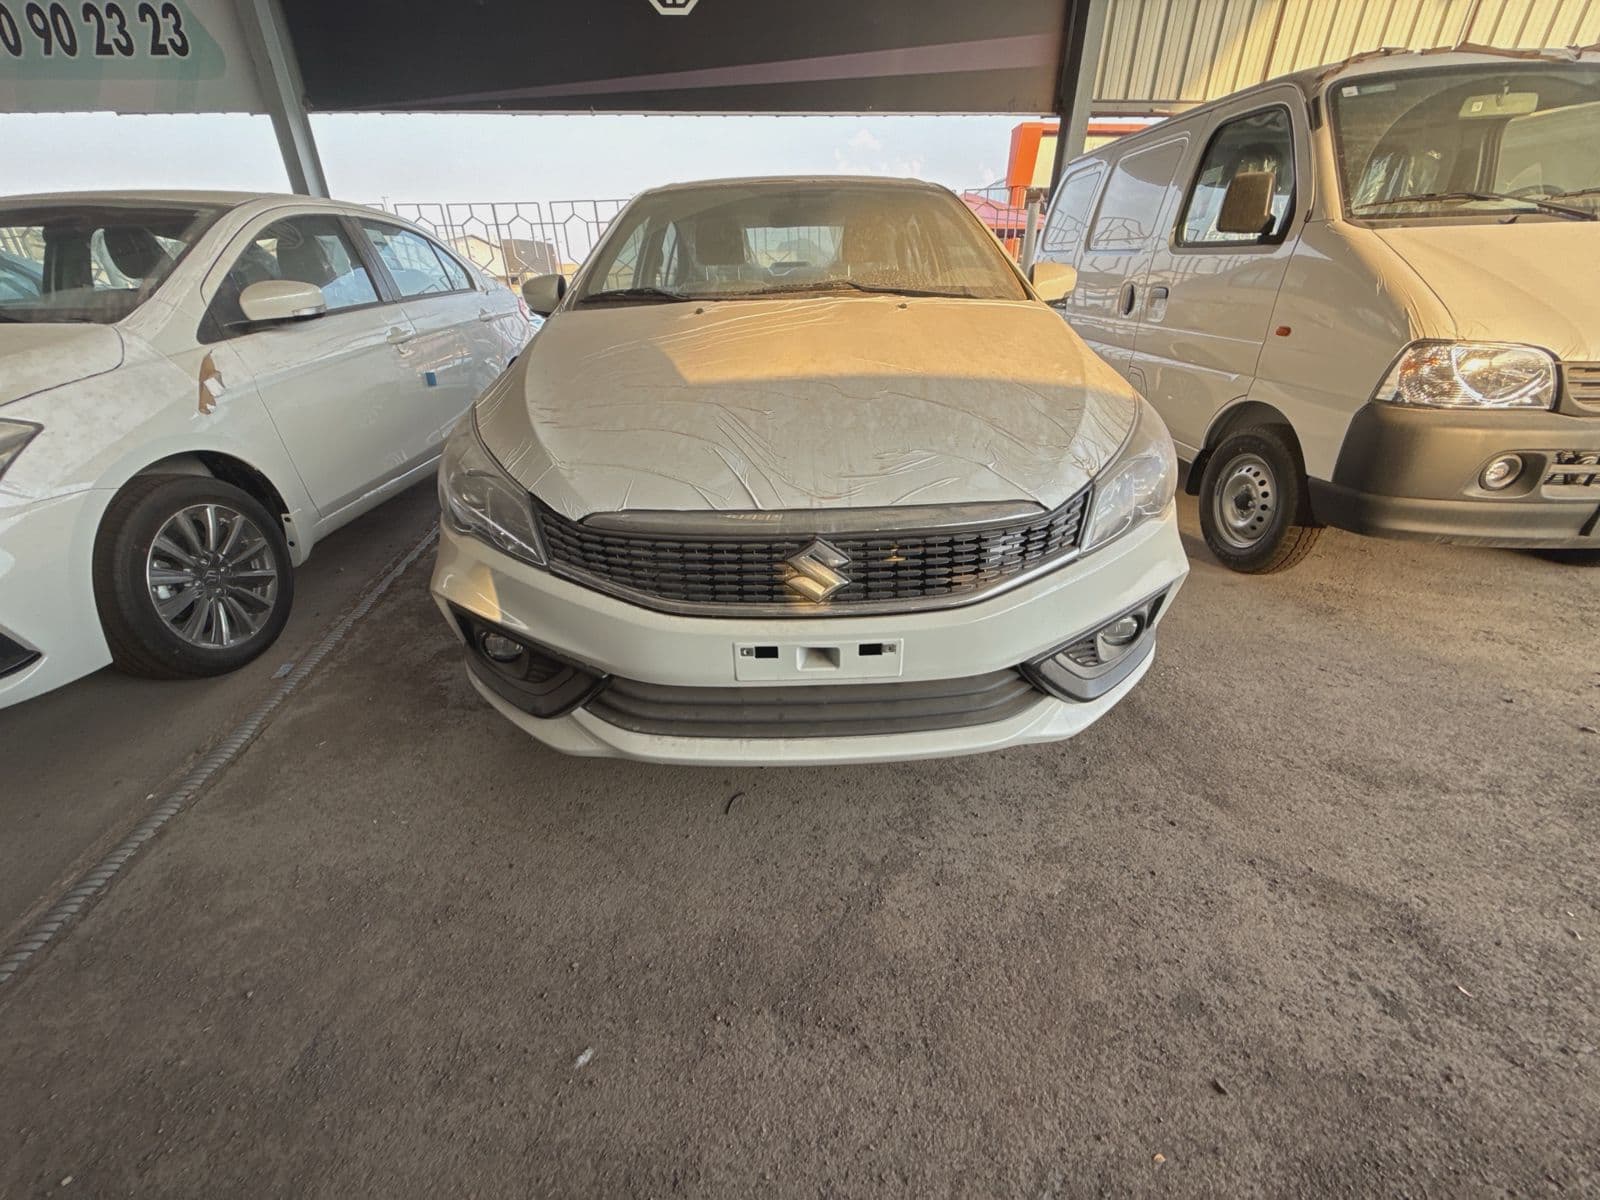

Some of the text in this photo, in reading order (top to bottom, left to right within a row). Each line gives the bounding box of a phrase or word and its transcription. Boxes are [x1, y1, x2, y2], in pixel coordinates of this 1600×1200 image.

[26, 2, 78, 57] 90
[82, 2, 135, 57] 23
[138, 2, 189, 57] 23
